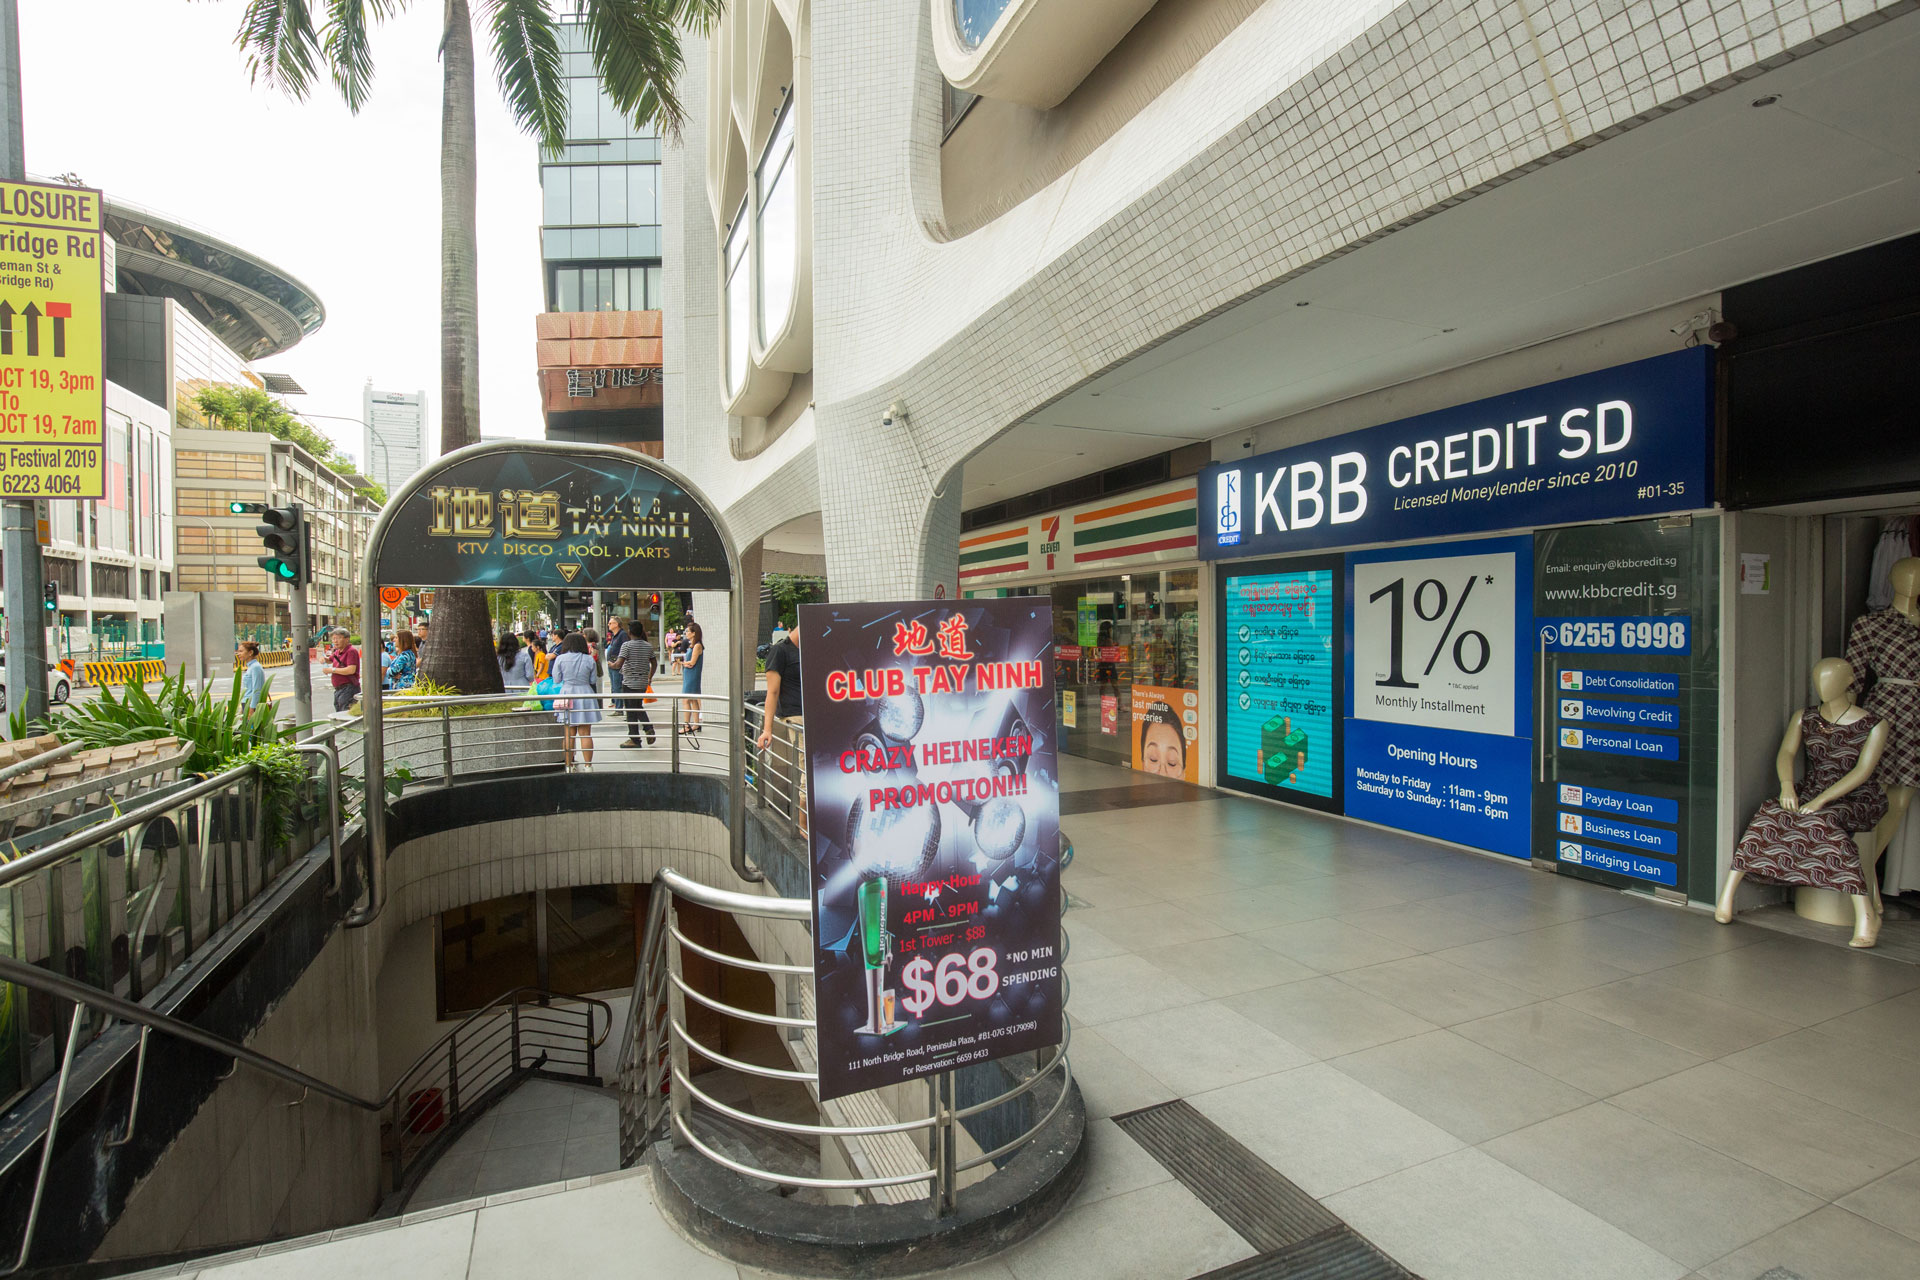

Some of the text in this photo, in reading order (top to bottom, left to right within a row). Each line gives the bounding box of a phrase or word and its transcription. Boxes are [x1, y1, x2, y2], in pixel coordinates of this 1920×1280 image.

[67, 234, 96, 259] Rd
[37, 262, 49, 274] St
[53, 264, 61, 274] &
[35, 276, 54, 290] Rd)
[0, 367, 95, 394] CT 19, 3pm
[0, 390, 19, 411] To
[33, 414, 57, 438] 19,
[62, 415, 97, 435] 7am
[10, 448, 61, 468] Festival
[64, 450, 97, 468] 2019
[1254, 451, 1368, 535] KBB
[1388, 415, 1548, 488] CREDIT
[1558, 399, 1633, 460] SD
[2, 474, 81, 494] 6223 4064
[1393, 460, 1638, 511] Licensed Moneylender since 2010
[1638, 481, 1685, 501] #01-35
[427, 485, 561, 540] 地道
[566, 508, 690, 538] TAY NINH
[457, 542, 671, 559] KTV DISCO POOL DARTS
[1546, 557, 1677, 574] Email: enquiry@kbbcredit.sg
[386, 590, 397, 599] 30
[1545, 582, 1677, 600] www.kbbcredit.sg
[892, 613, 974, 661] 地道
[1560, 622, 1685, 648] 6255 6998
[826, 661, 1043, 702] CLUB TAY NINH
[1585, 676, 1675, 690] Debt Consolidation
[1132, 699, 1169, 712] last minute
[1148, 692, 1165, 700] Always
[1375, 695, 1485, 715] Monthly Installment
[1132, 712, 1163, 724] groceries
[1586, 705, 1673, 722] Revolving Credit
[839, 735, 1033, 774] CRAZY HEINEKEN
[1387, 743, 1478, 769] Opening Hours
[1586, 735, 1663, 753] Personal Loan
[869, 773, 1028, 812] PROMOTION!!!
[1356, 767, 1390, 785] Monday
[1391, 772, 1400, 784] to
[1402, 774, 1431, 793] Friday
[1448, 784, 1475, 799] 11am
[1484, 790, 1508, 805] 9pm
[1356, 780, 1393, 799] Saturday
[1395, 787, 1405, 798] to
[1406, 789, 1442, 808] Sunday
[1449, 798, 1475, 813] 11am
[1485, 804, 1509, 820] 6pm
[1585, 792, 1653, 813] Payday Loan
[1585, 821, 1661, 845] Business Loan
[1584, 850, 1661, 876] Bridging Loan
[903, 908, 935, 925] 4PM
[948, 901, 979, 918] 9PM
[899, 939, 916, 953] 1st
[919, 932, 955, 949] Tower
[965, 925, 986, 942] $88
[1030, 946, 1054, 959] MIN
[901, 946, 1000, 1019] $68
[1001, 966, 1058, 987] SPENDING
[848, 1061, 860, 1071] 111
[862, 1056, 882, 1069] North
[883, 1052, 905, 1065] Bridge
[906, 1046, 925, 1058] Road,
[926, 1039, 957, 1054] Peninsula
[958, 1035, 976, 1047] Plaza,
[902, 1048, 989, 1076] For Reservation: 6659 6433
